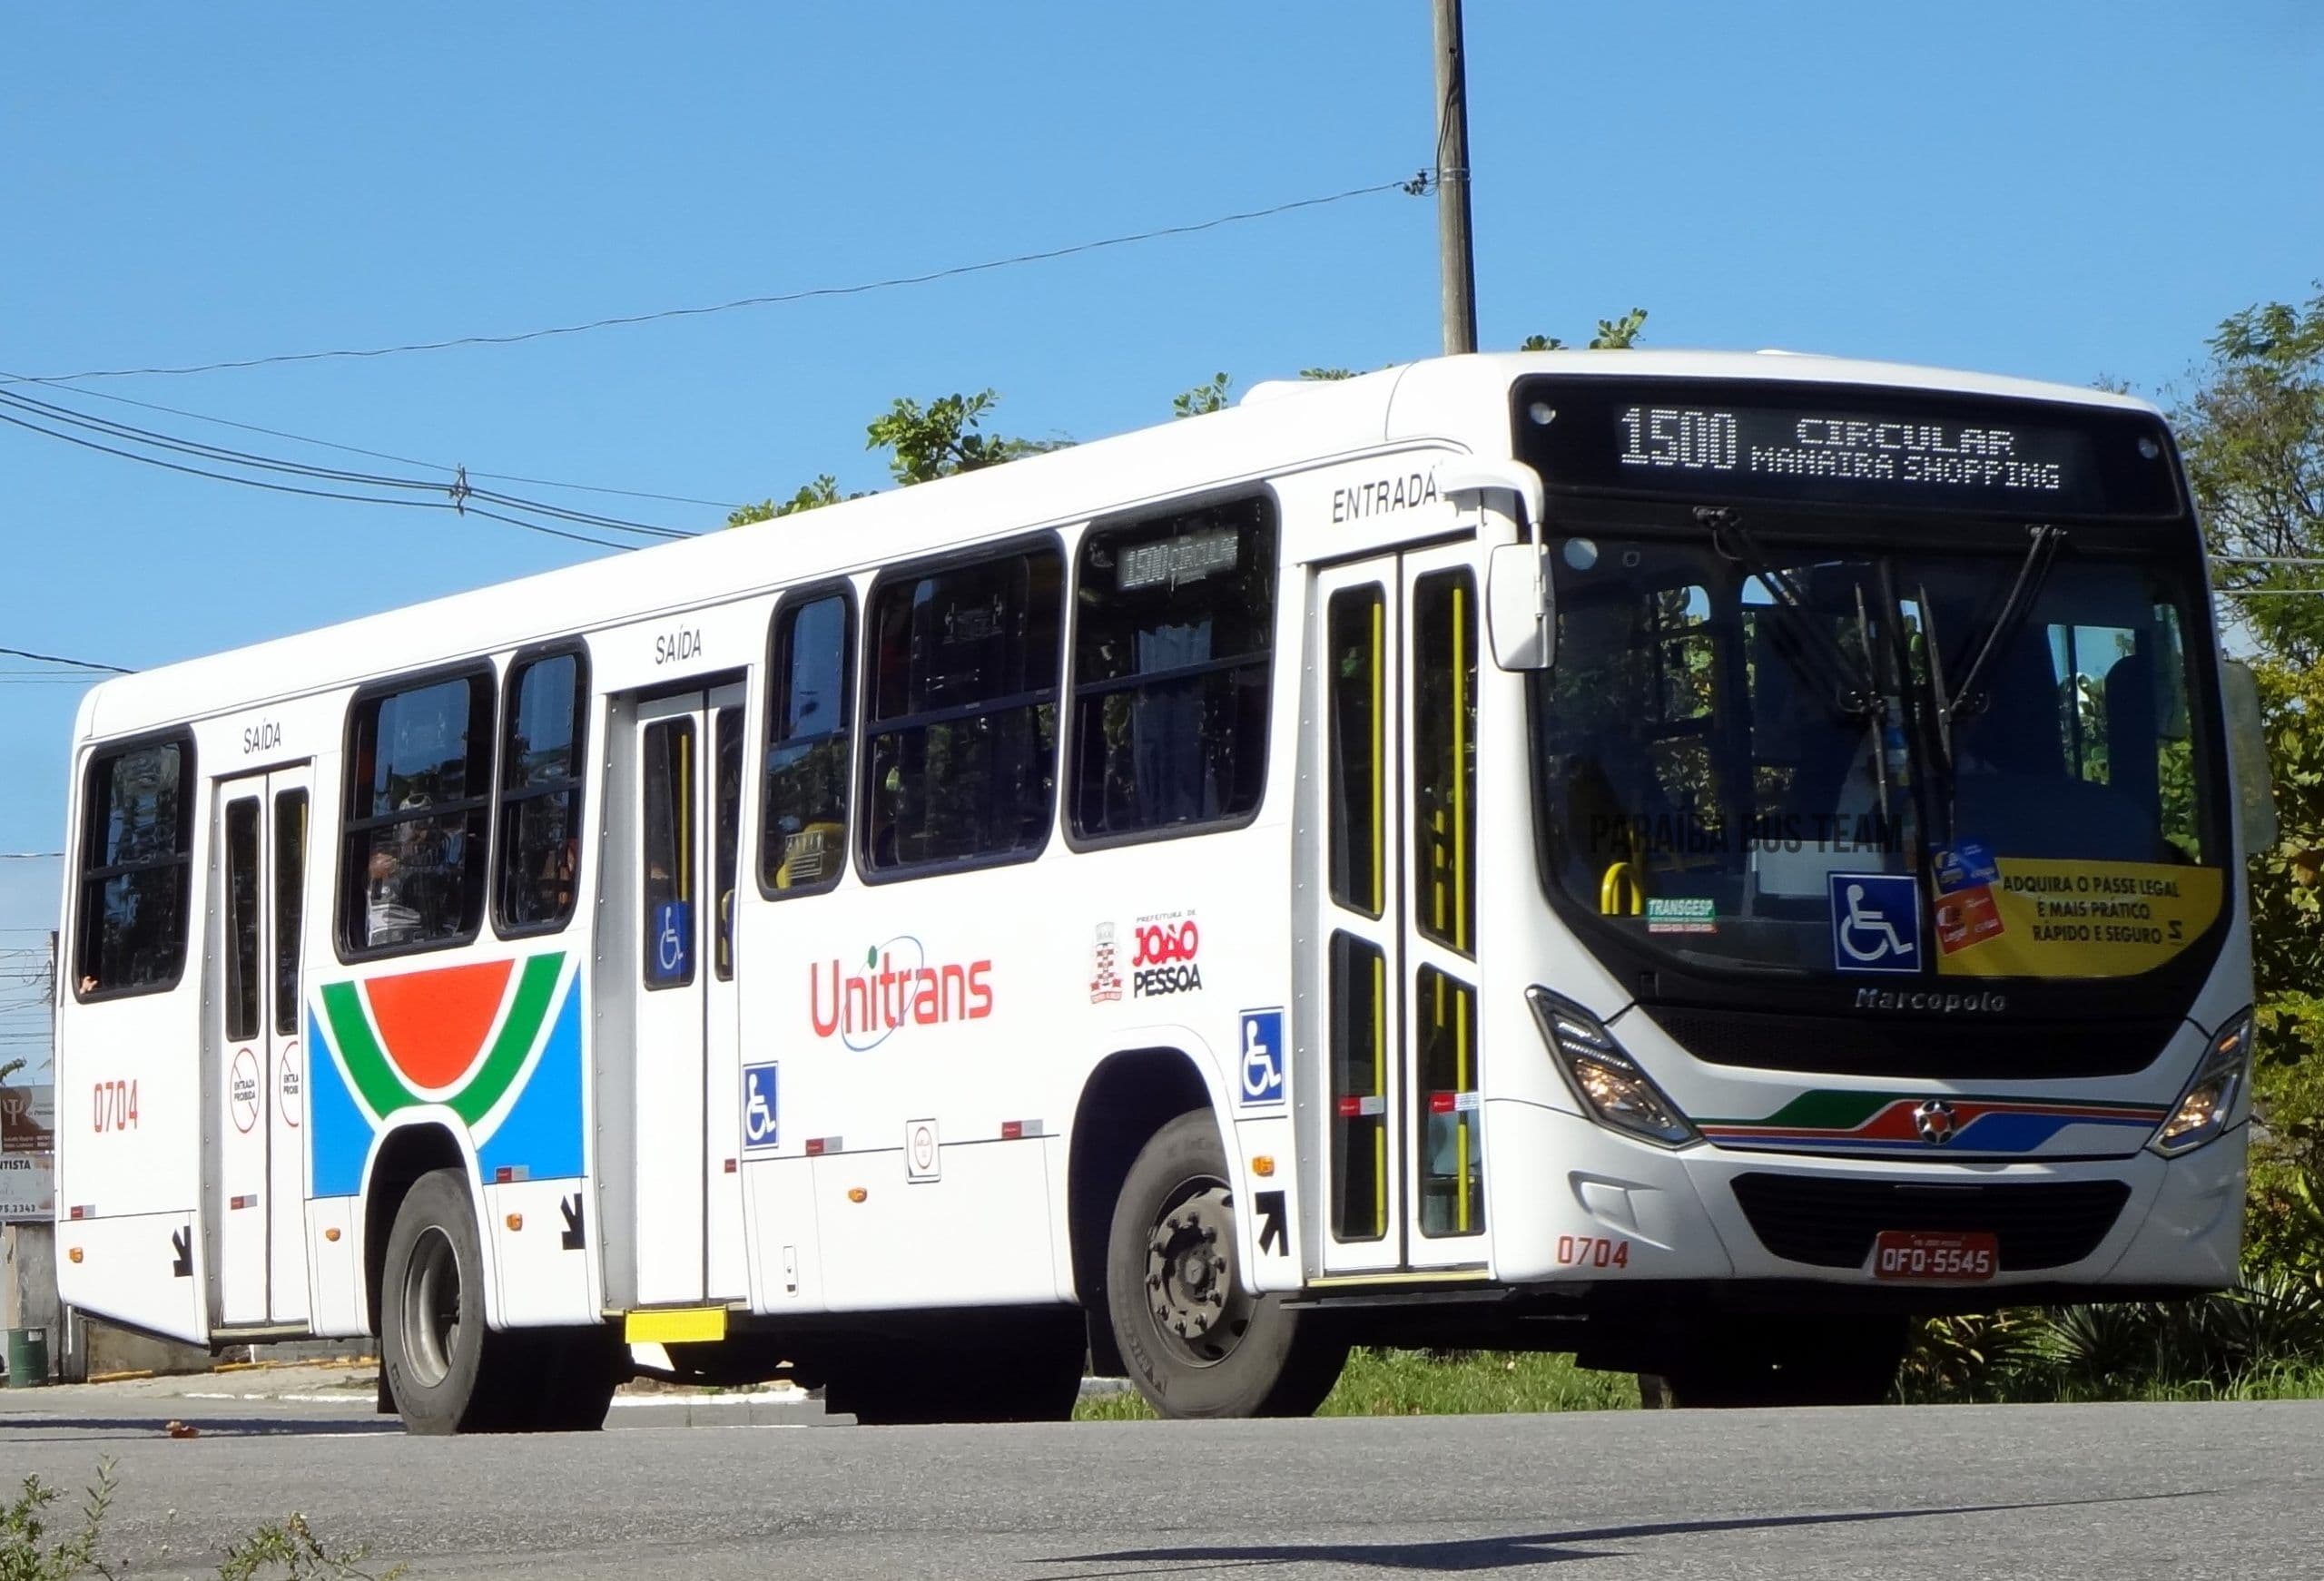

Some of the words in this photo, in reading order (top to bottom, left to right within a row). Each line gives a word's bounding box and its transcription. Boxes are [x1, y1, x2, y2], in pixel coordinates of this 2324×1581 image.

[1620, 407, 1737, 470] 1500
[1797, 417, 2015, 457] CIRCULAR
[1903, 455, 2061, 489] SHOPPING
[1333, 471, 1437, 523] ENTRADA
[655, 624, 702, 665] SAÍDA
[243, 717, 281, 754] SAÍDA
[2004, 877, 2073, 892] ADQUIRA
[2076, 876, 2089, 892] O
[2093, 877, 2137, 894] PASSE
[2141, 880, 2181, 898] LEGAL
[2050, 902, 2088, 918] MAIS
[2094, 925, 2103, 941] E
[2106, 926, 2162, 943] SEGURO
[811, 950, 993, 1038] Unitrans
[1134, 963, 1203, 998] PESSOA
[1855, 988, 2006, 1013] Marcopolo
[94, 1079, 138, 1133] 0704
[1558, 1235, 1629, 1269] 0704
